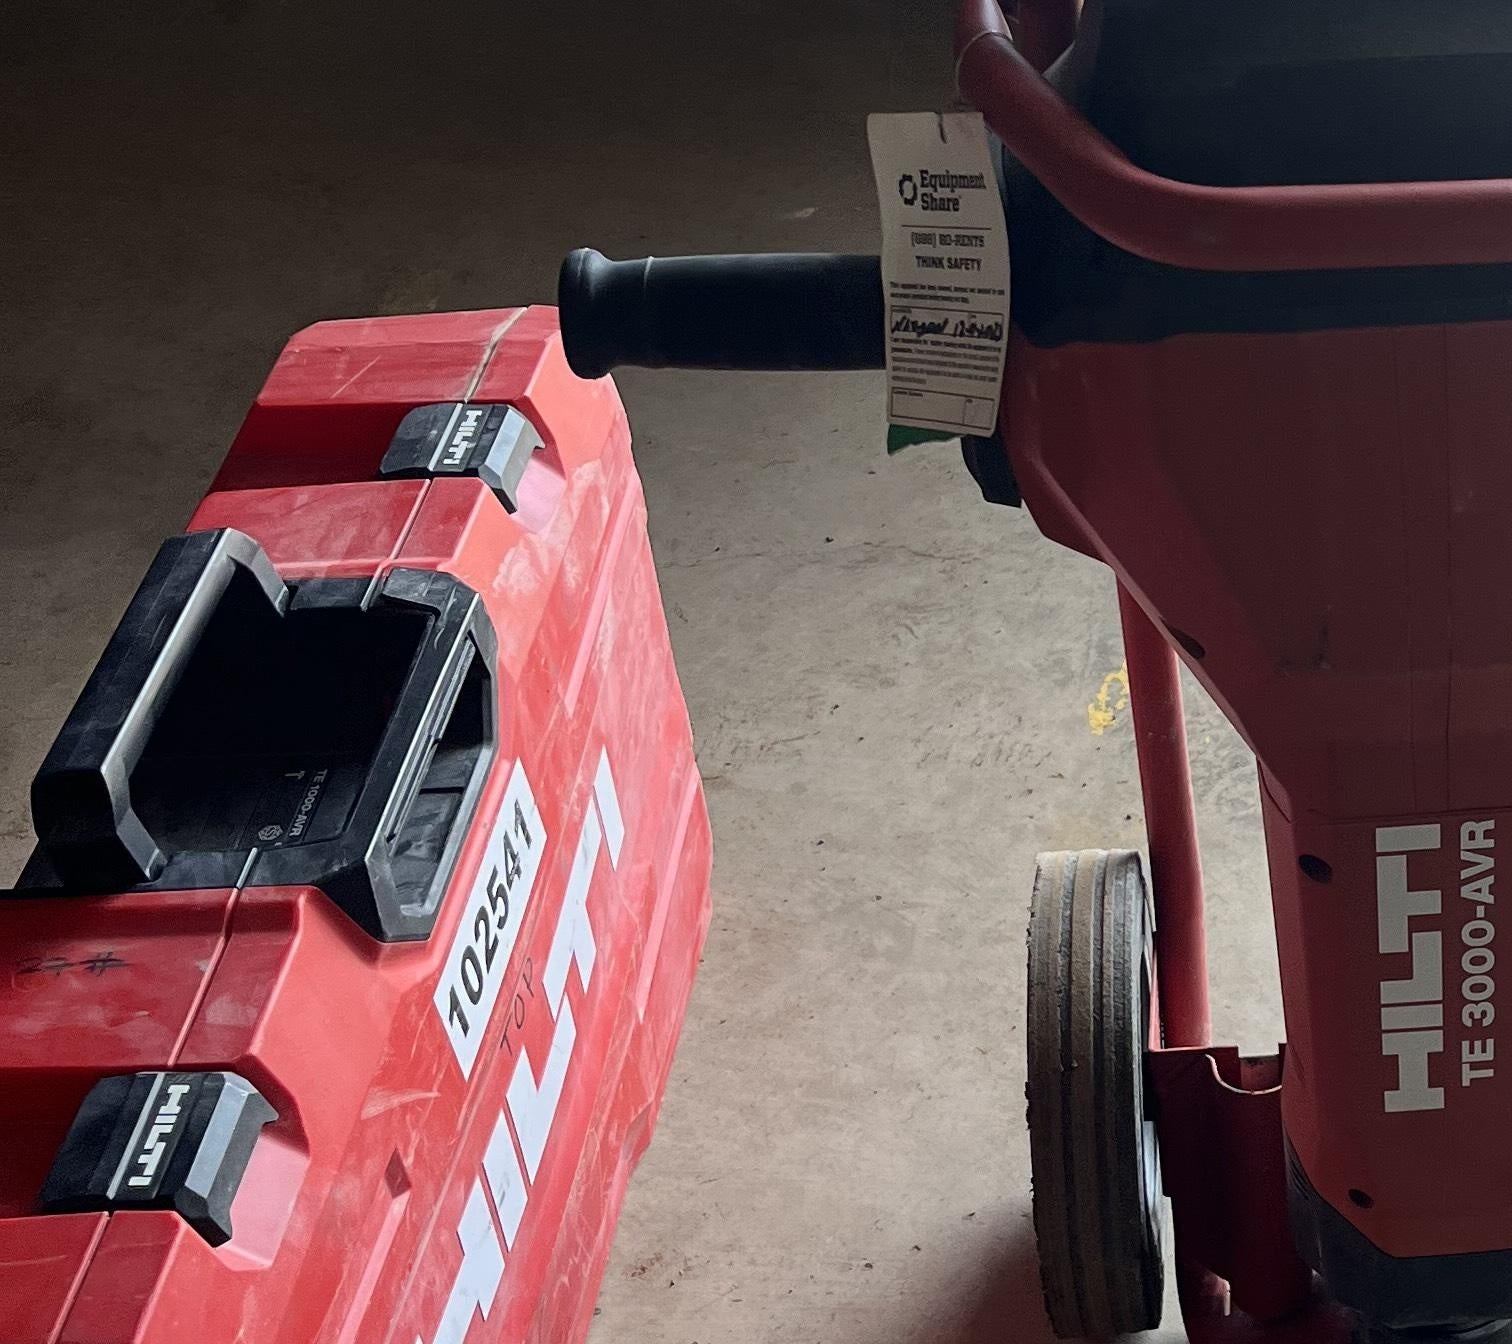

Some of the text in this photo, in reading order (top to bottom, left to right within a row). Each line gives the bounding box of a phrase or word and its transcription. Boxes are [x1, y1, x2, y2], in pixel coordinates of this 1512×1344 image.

[919, 169, 987, 193] Equipment
[921, 192, 960, 212] Share
[915, 255, 982, 273] THINK SAFETY
[443, 409, 483, 466] HILTI
[288, 768, 328, 837] TE 1000-AVR
[449, 797, 532, 1039] 102541
[1374, 822, 1446, 1114] HILTI
[1459, 818, 1497, 1088] TE 3000-AVR
[127, 1083, 192, 1187] HILTI
